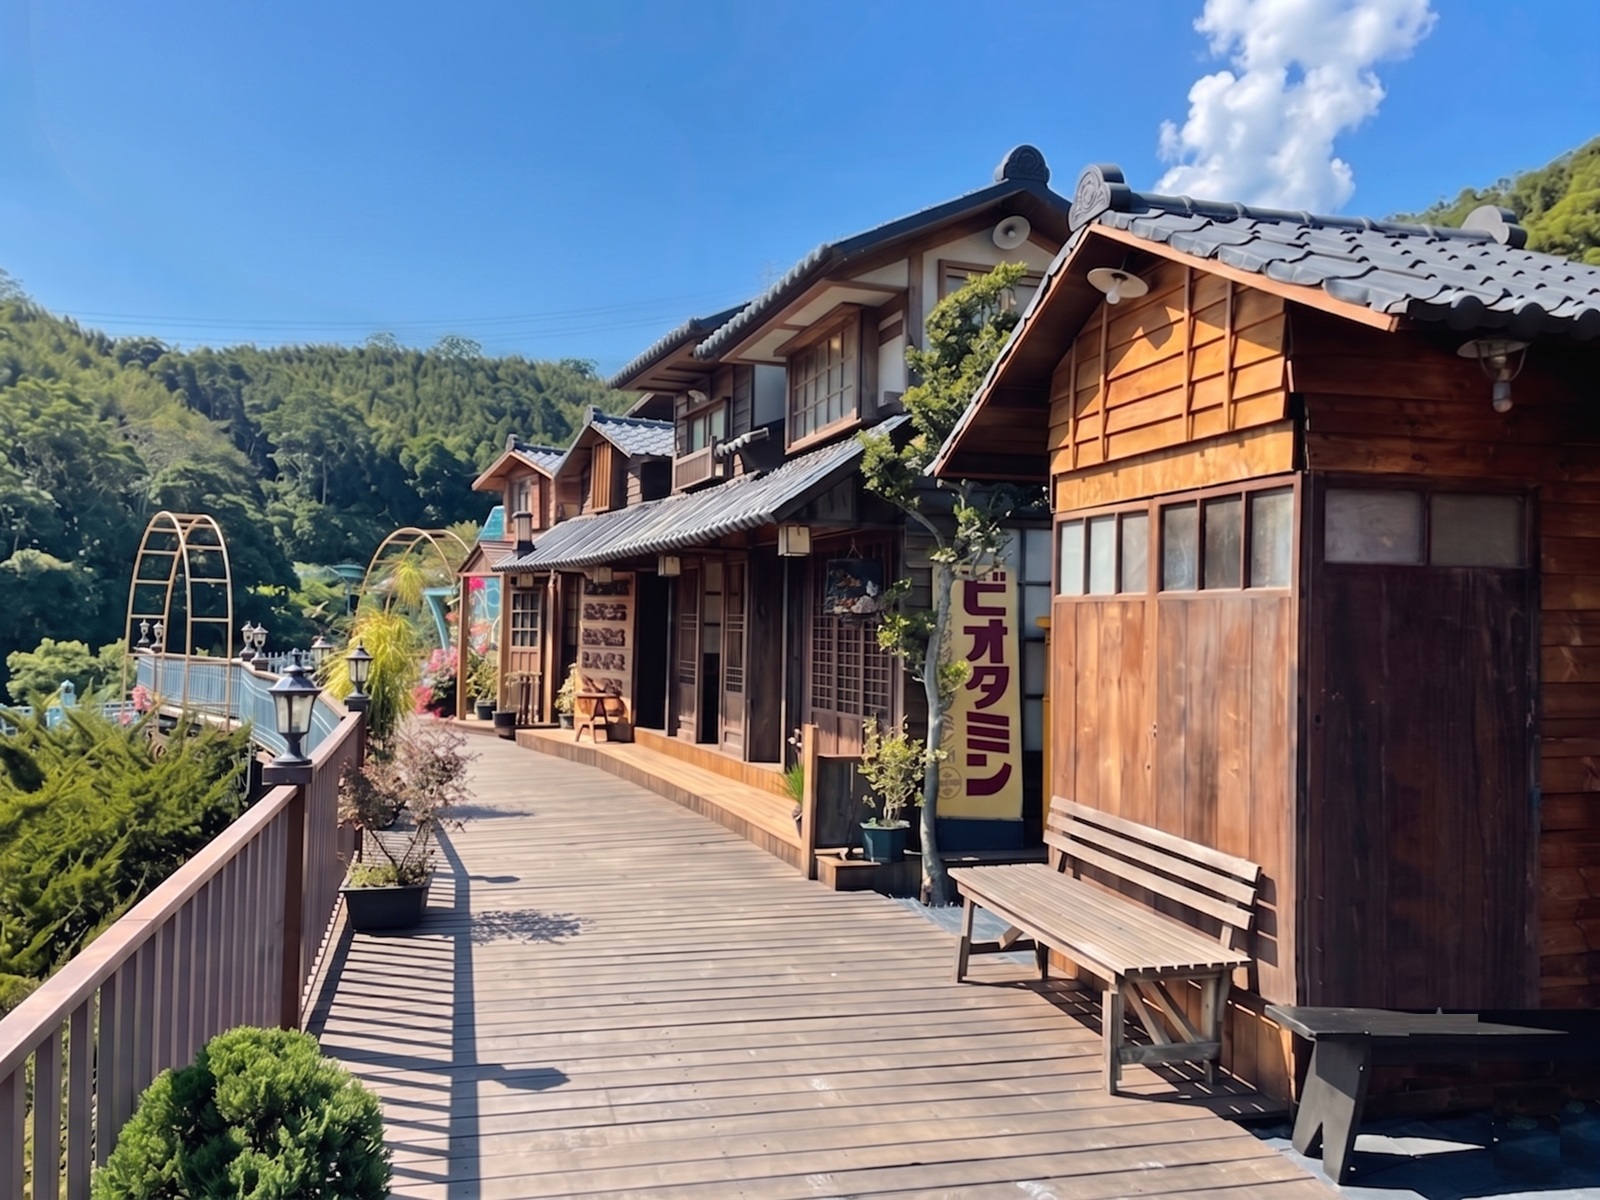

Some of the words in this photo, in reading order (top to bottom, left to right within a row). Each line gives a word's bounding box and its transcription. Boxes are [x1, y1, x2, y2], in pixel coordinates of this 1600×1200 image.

[962, 571, 1013, 797] ビオタミン
